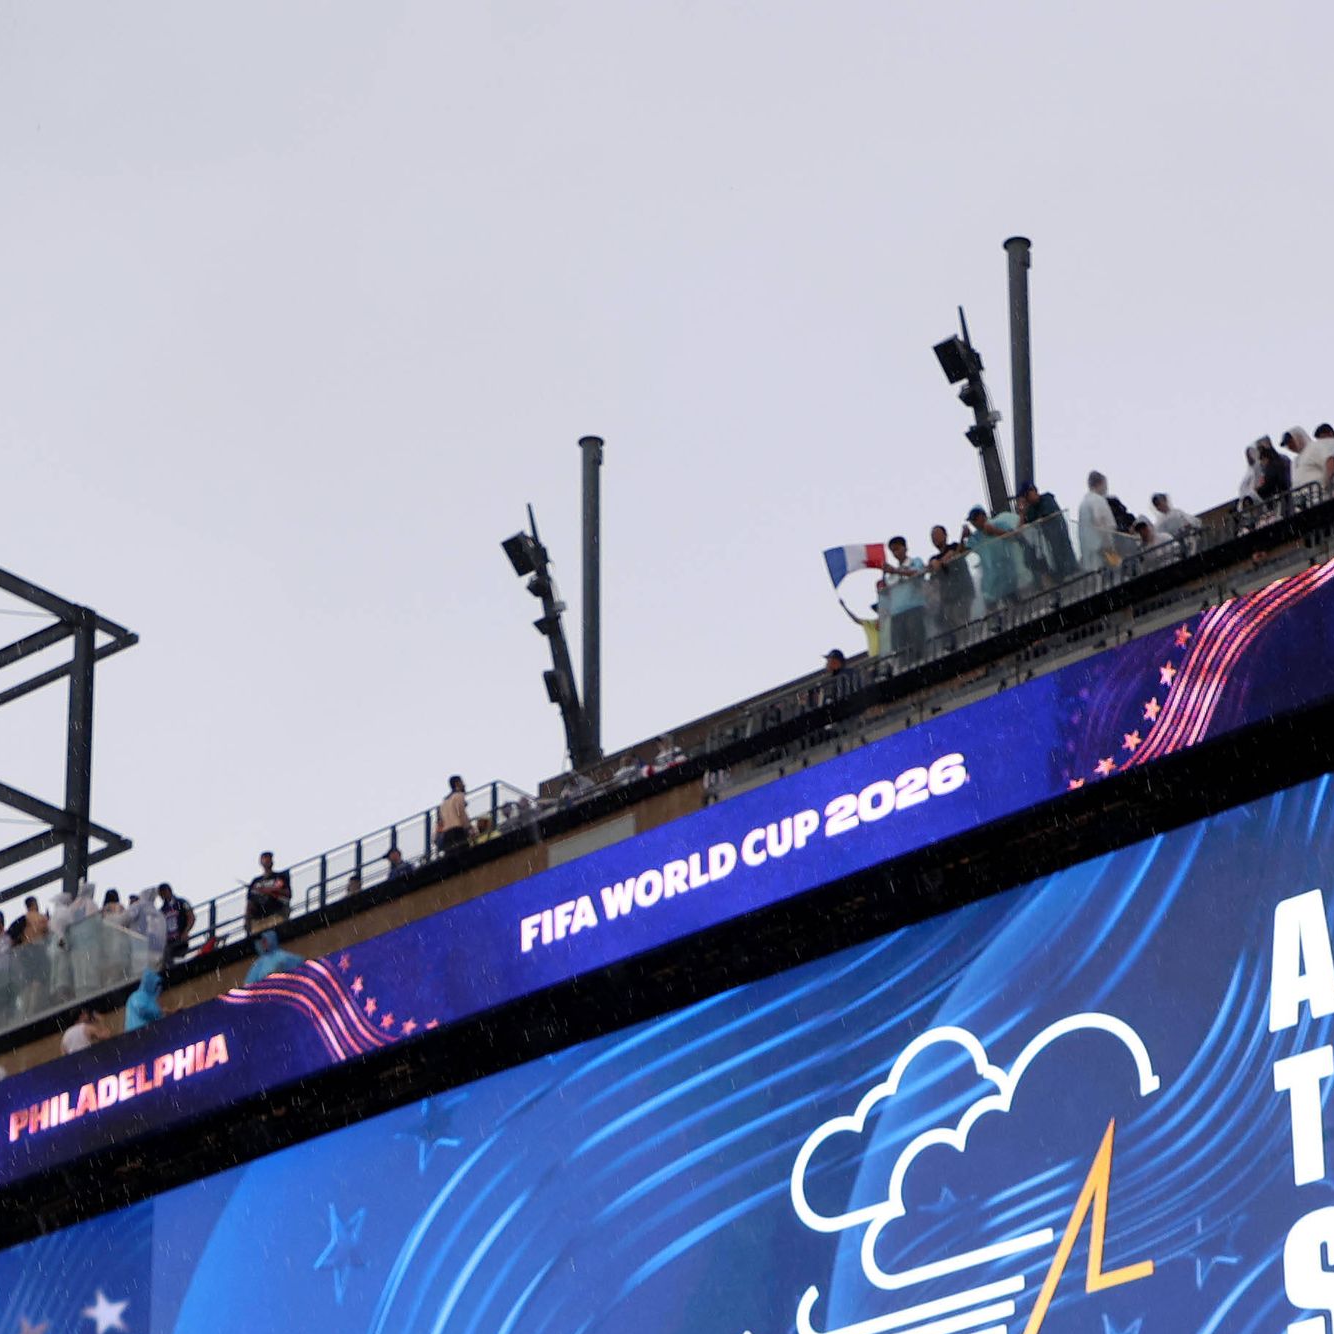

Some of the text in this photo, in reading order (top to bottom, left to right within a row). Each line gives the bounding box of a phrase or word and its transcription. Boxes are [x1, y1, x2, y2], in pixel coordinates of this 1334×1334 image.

[520, 752, 967, 953] FIFA WORLD CUP 2026
[8, 1032, 229, 1143] PHILADELPHIA
